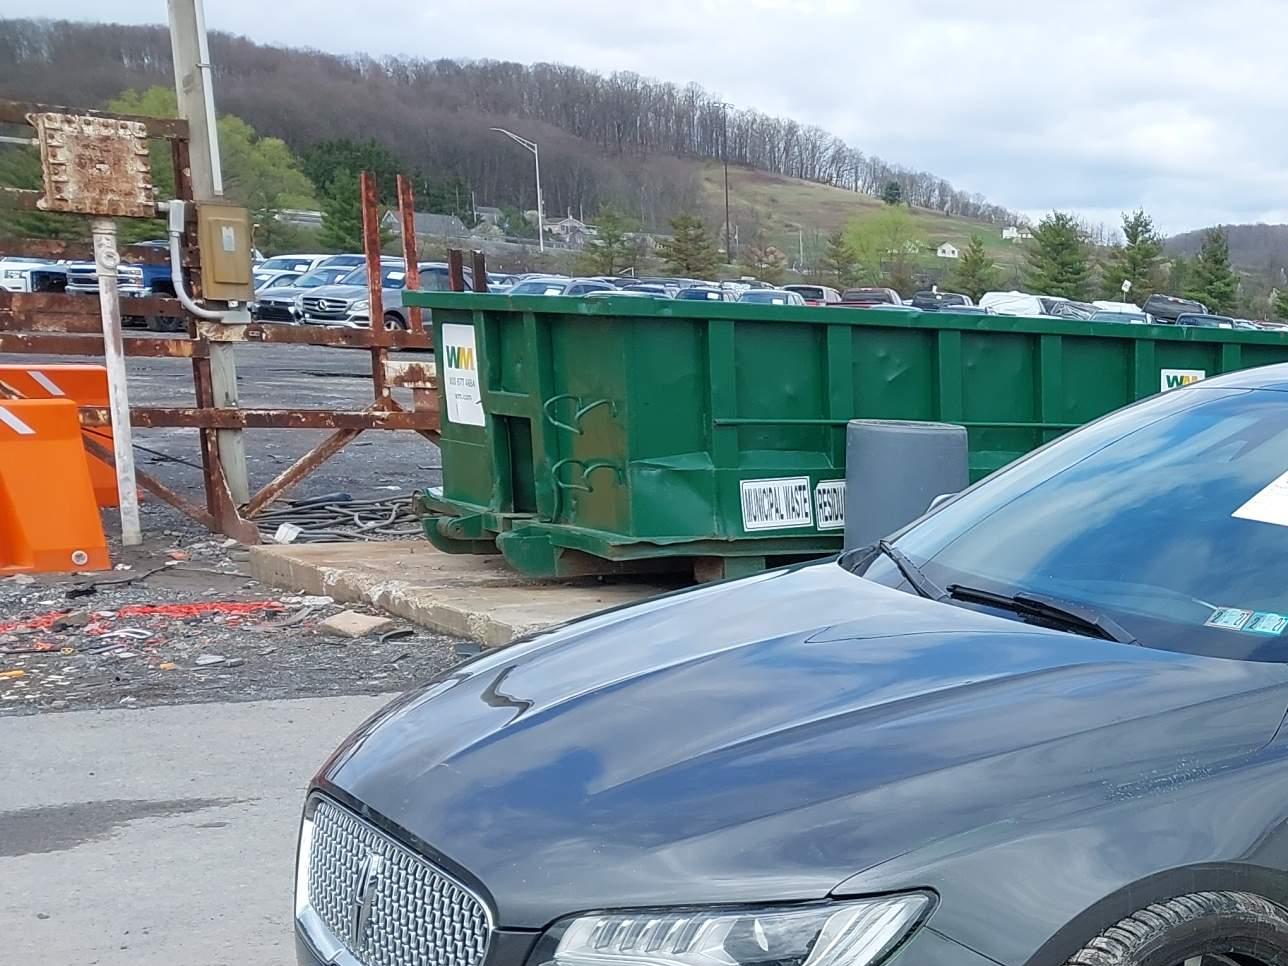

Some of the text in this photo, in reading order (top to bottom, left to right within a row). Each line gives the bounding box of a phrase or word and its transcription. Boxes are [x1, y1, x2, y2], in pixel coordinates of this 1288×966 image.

[446, 345, 474, 370] WM
[744, 484, 809, 522] MUNICIPAL WASTE
